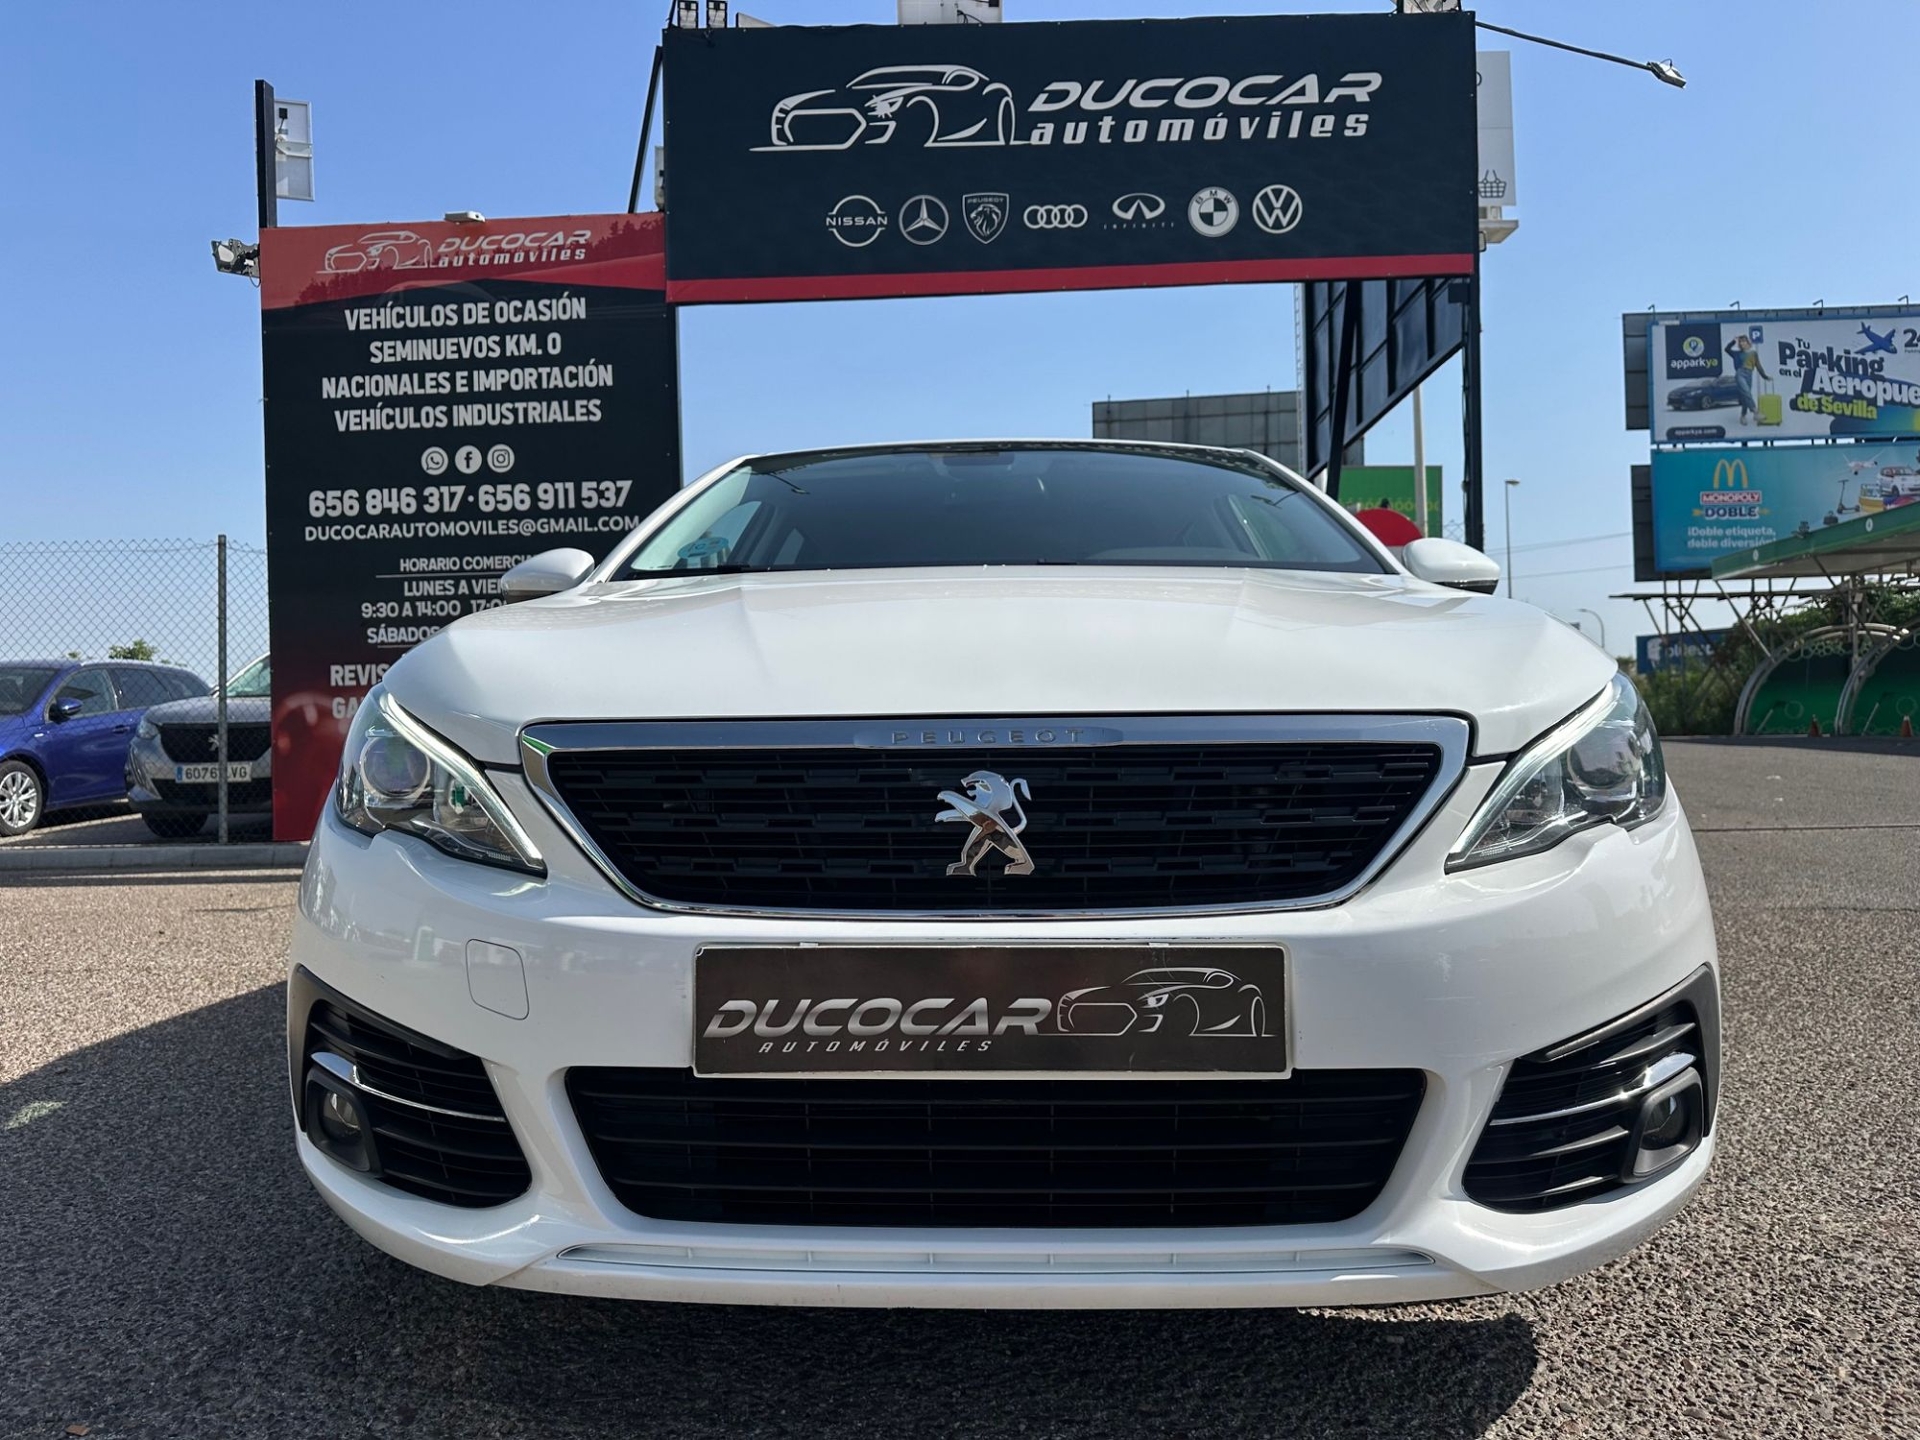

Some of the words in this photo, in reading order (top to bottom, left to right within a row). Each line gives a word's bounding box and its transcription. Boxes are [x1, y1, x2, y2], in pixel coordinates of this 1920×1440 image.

[1028, 72, 1382, 112] DUCOCAR
[1030, 111, 1370, 145] automóviles
[826, 215, 888, 227] NISSAN
[437, 230, 592, 252] DUCOCAR
[344, 300, 459, 331] VEHÍCULOS
[463, 302, 490, 325] DE
[494, 292, 587, 324] OCASIÓN
[1795, 337, 1811, 350] Tu
[1903, 328, 1920, 348] 2
[370, 334, 501, 364] SEMINUEVOS
[506, 334, 543, 357] KM.
[1670, 357, 1718, 370] apparkya
[1778, 340, 1885, 380] Parking
[322, 371, 451, 399] NACIONALES
[456, 370, 468, 393] E
[473, 358, 614, 393] IMPORTACIÓN
[1779, 368, 1792, 377] en
[1793, 367, 1802, 378] el
[334, 400, 448, 432] VEHÍCULOS
[452, 399, 602, 427] INDUSTRIALES
[1797, 392, 1819, 411] de
[1821, 395, 1878, 420] Sevilla
[309, 490, 359, 518] 656
[365, 487, 417, 516] 846
[536, 481, 576, 510] 911
[581, 480, 633, 508] 537
[1702, 492, 1760, 503] MONOPOLY
[1704, 505, 1759, 519] DOBLE
[305, 515, 641, 542] DUCOCARAUTOMOVILES@GMAIL.COM
[1687, 537, 1720, 548] doble
[400, 557, 460, 572] HORARIO
[404, 580, 455, 597] LUNES
[458, 579, 469, 595] A
[361, 602, 399, 619] 9:30
[402, 602, 413, 617] A
[415, 600, 461, 617] 14:00
[891, 729, 1084, 744] PEUGEOT
[185, 767, 218, 780] 6076
[703, 997, 1053, 1038] DUCOCAR
[758, 1037, 993, 1054] AUTOMÓVILES
